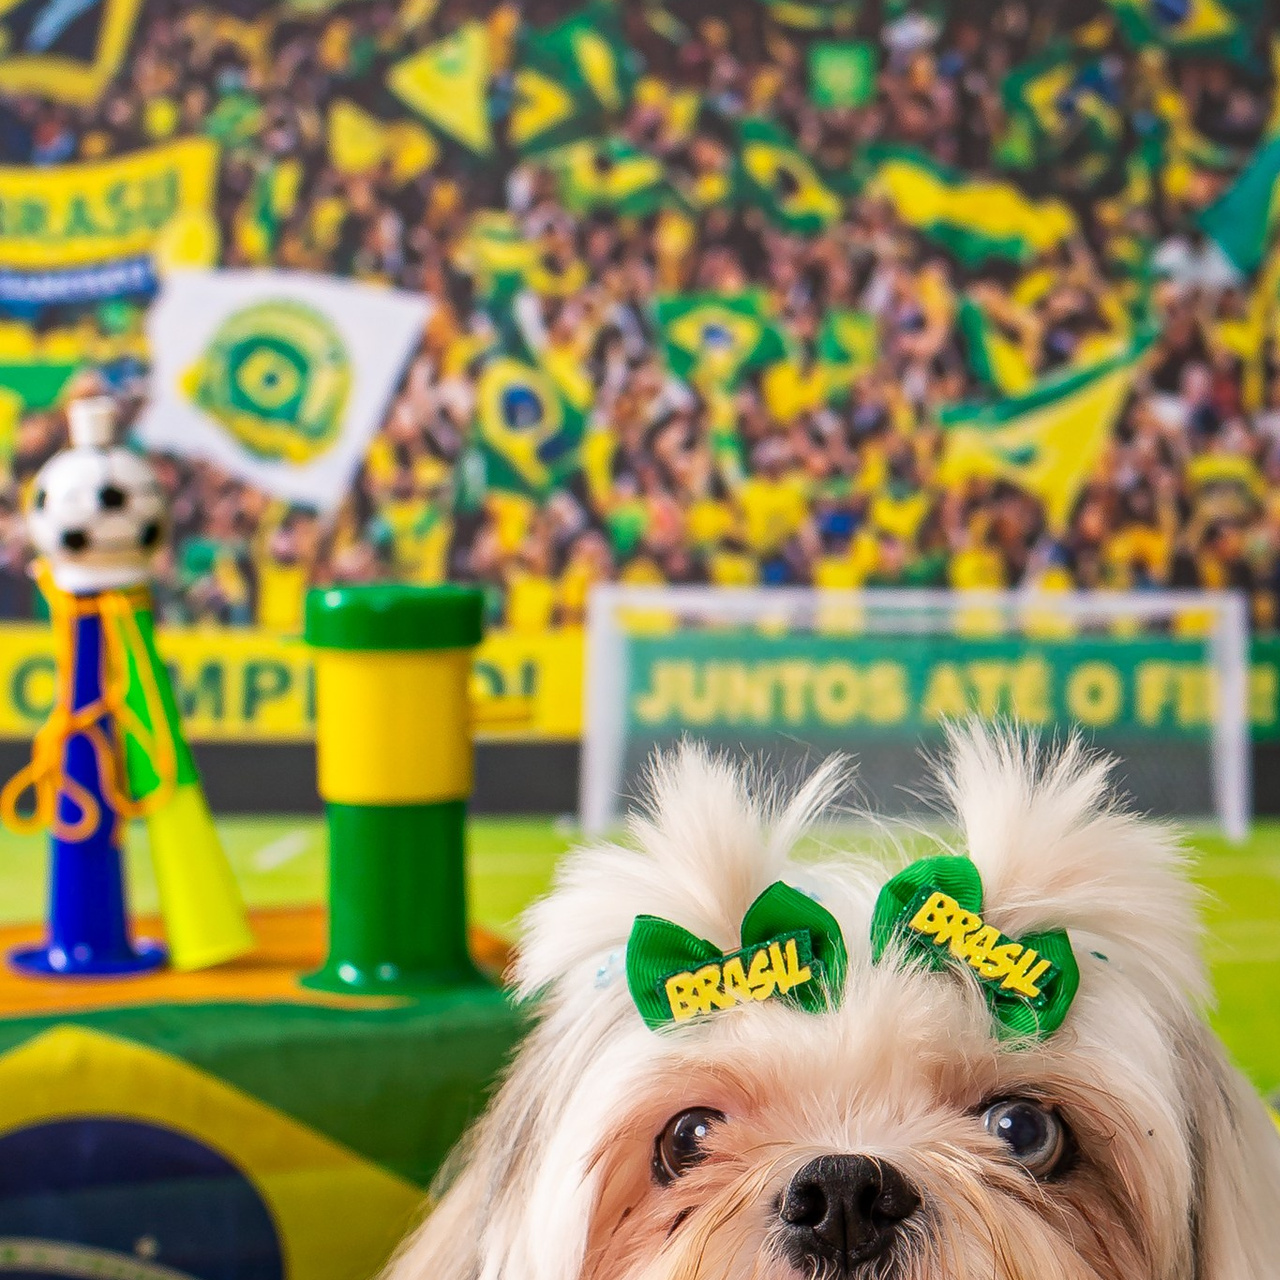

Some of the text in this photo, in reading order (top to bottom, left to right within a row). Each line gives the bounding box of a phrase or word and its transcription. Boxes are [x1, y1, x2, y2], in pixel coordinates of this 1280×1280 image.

[636, 660, 908, 722] JUNTOS
[923, 647, 1053, 722] ATÉ
[1065, 662, 1123, 724] O
[664, 938, 812, 1022] BRASIL
[908, 891, 1052, 998] BRASIL
